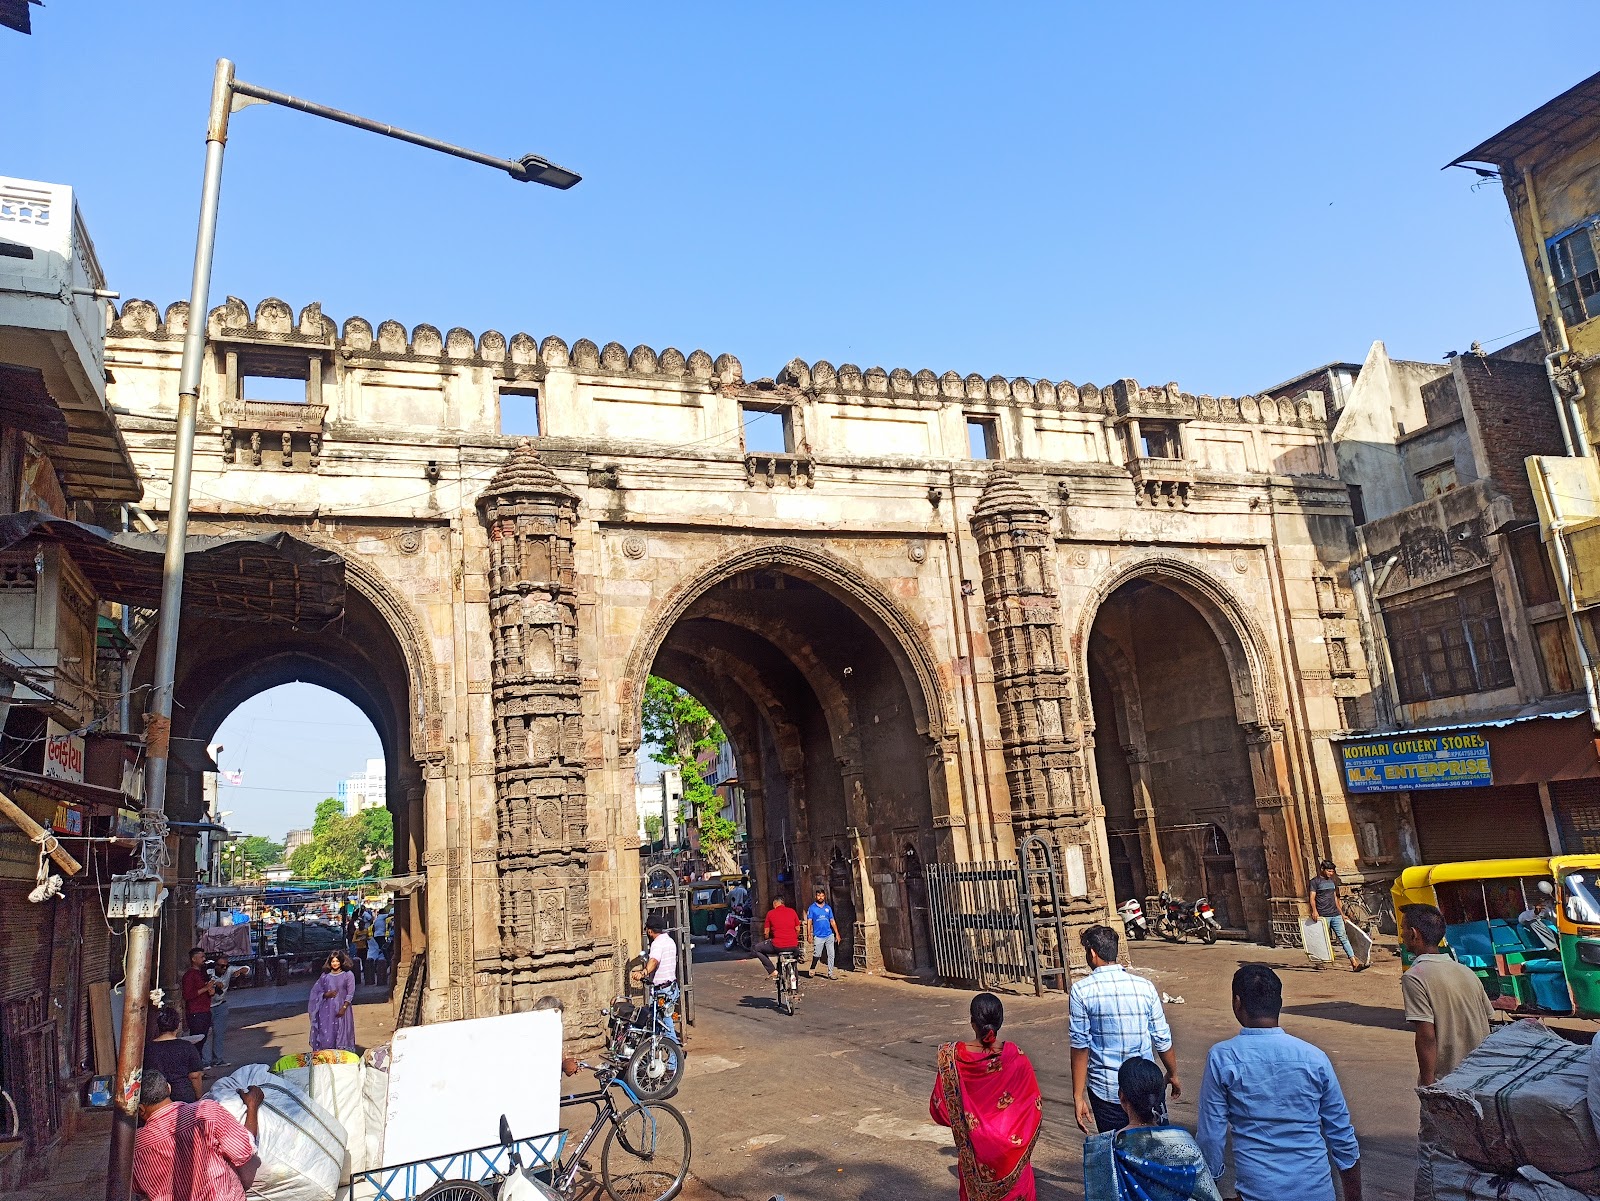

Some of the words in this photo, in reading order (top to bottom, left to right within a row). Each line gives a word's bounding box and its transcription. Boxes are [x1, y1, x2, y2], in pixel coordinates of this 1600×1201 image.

[1344, 744, 1390, 759] KOTHARI
[1393, 739, 1438, 755] CUTLERY
[1441, 734, 1485, 751] STORES
[1348, 766, 1382, 782] M.K.
[1384, 758, 1491, 780] ENTERPRISE
